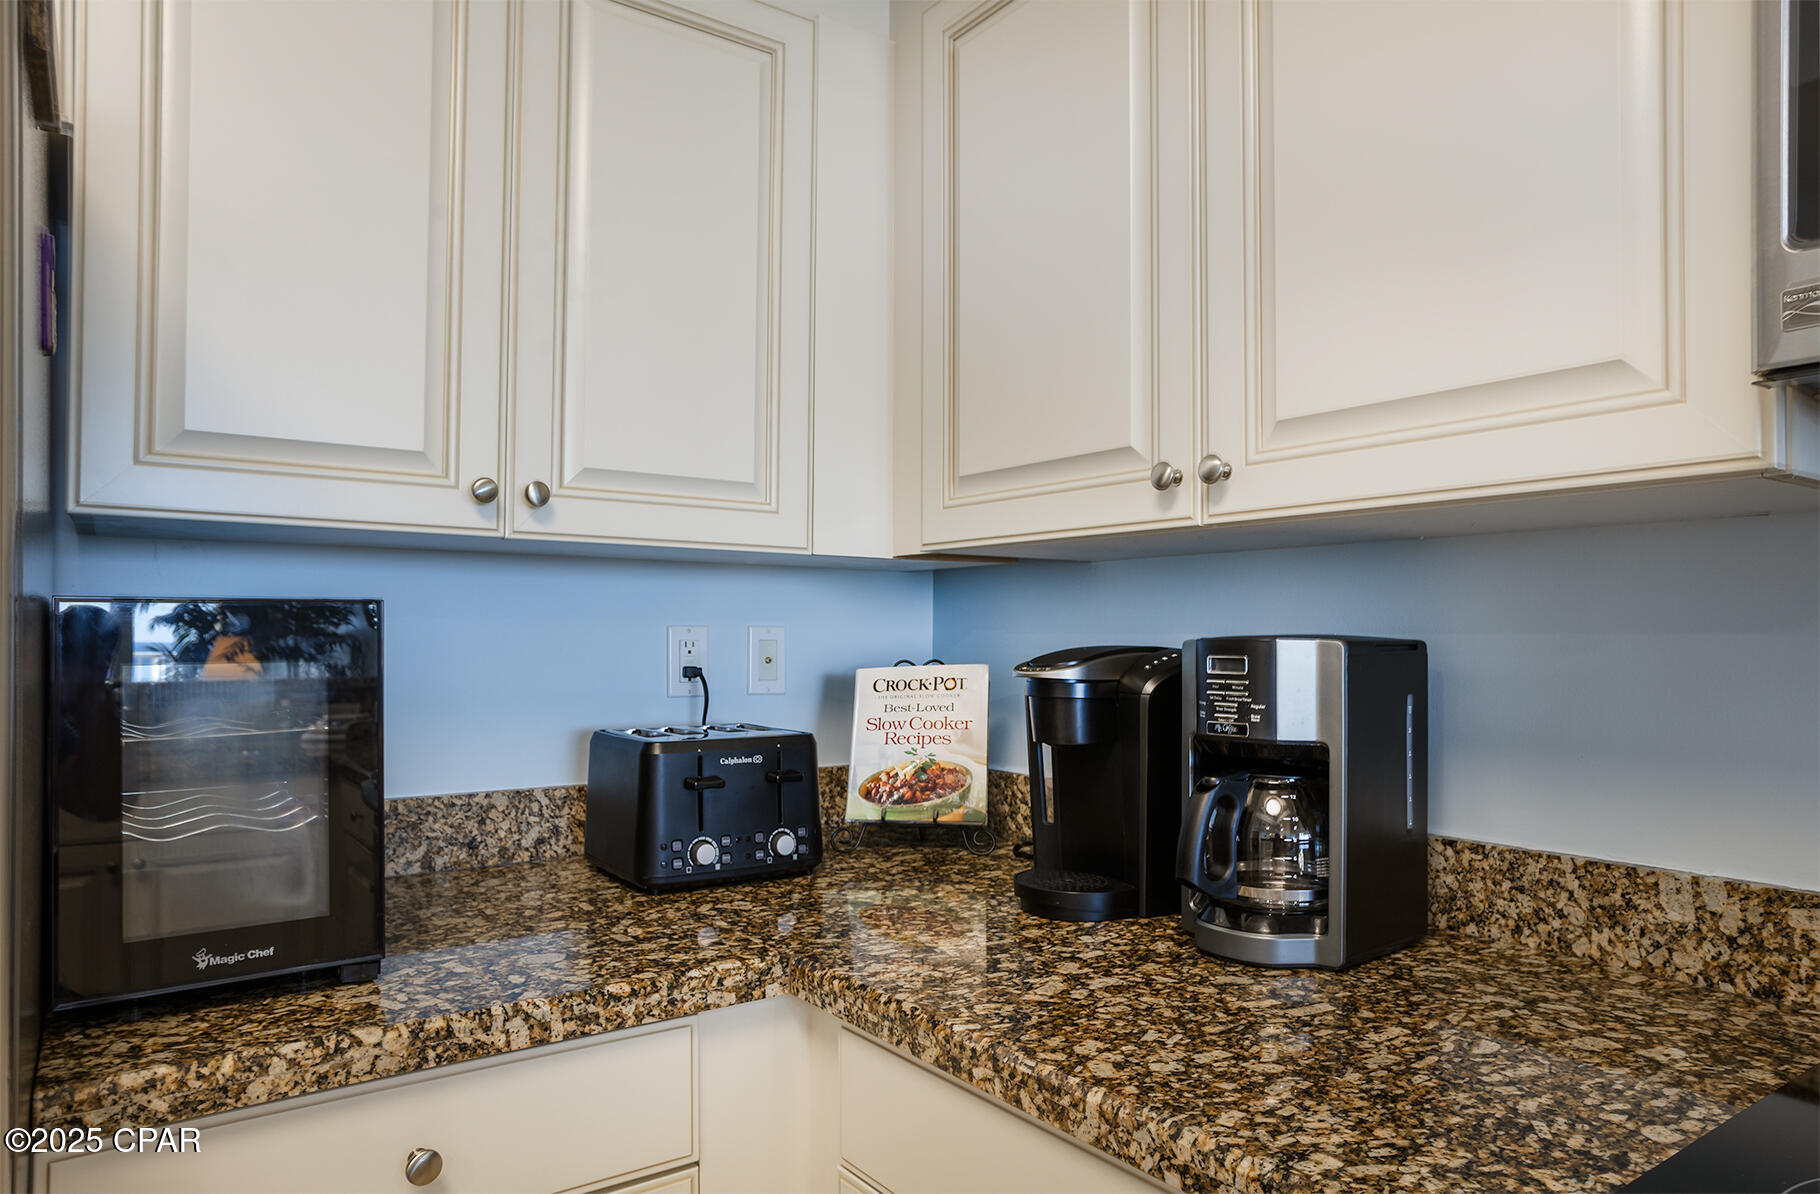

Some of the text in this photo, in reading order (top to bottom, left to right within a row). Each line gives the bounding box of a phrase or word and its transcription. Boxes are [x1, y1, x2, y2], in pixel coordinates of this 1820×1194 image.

[884, 702, 955, 713] Best-Loved
[866, 715, 973, 731] Slow Cooker
[884, 731, 952, 749] Recipes
[720, 756, 752, 765] Calphalon
[209, 946, 275, 966] Magic Chef
